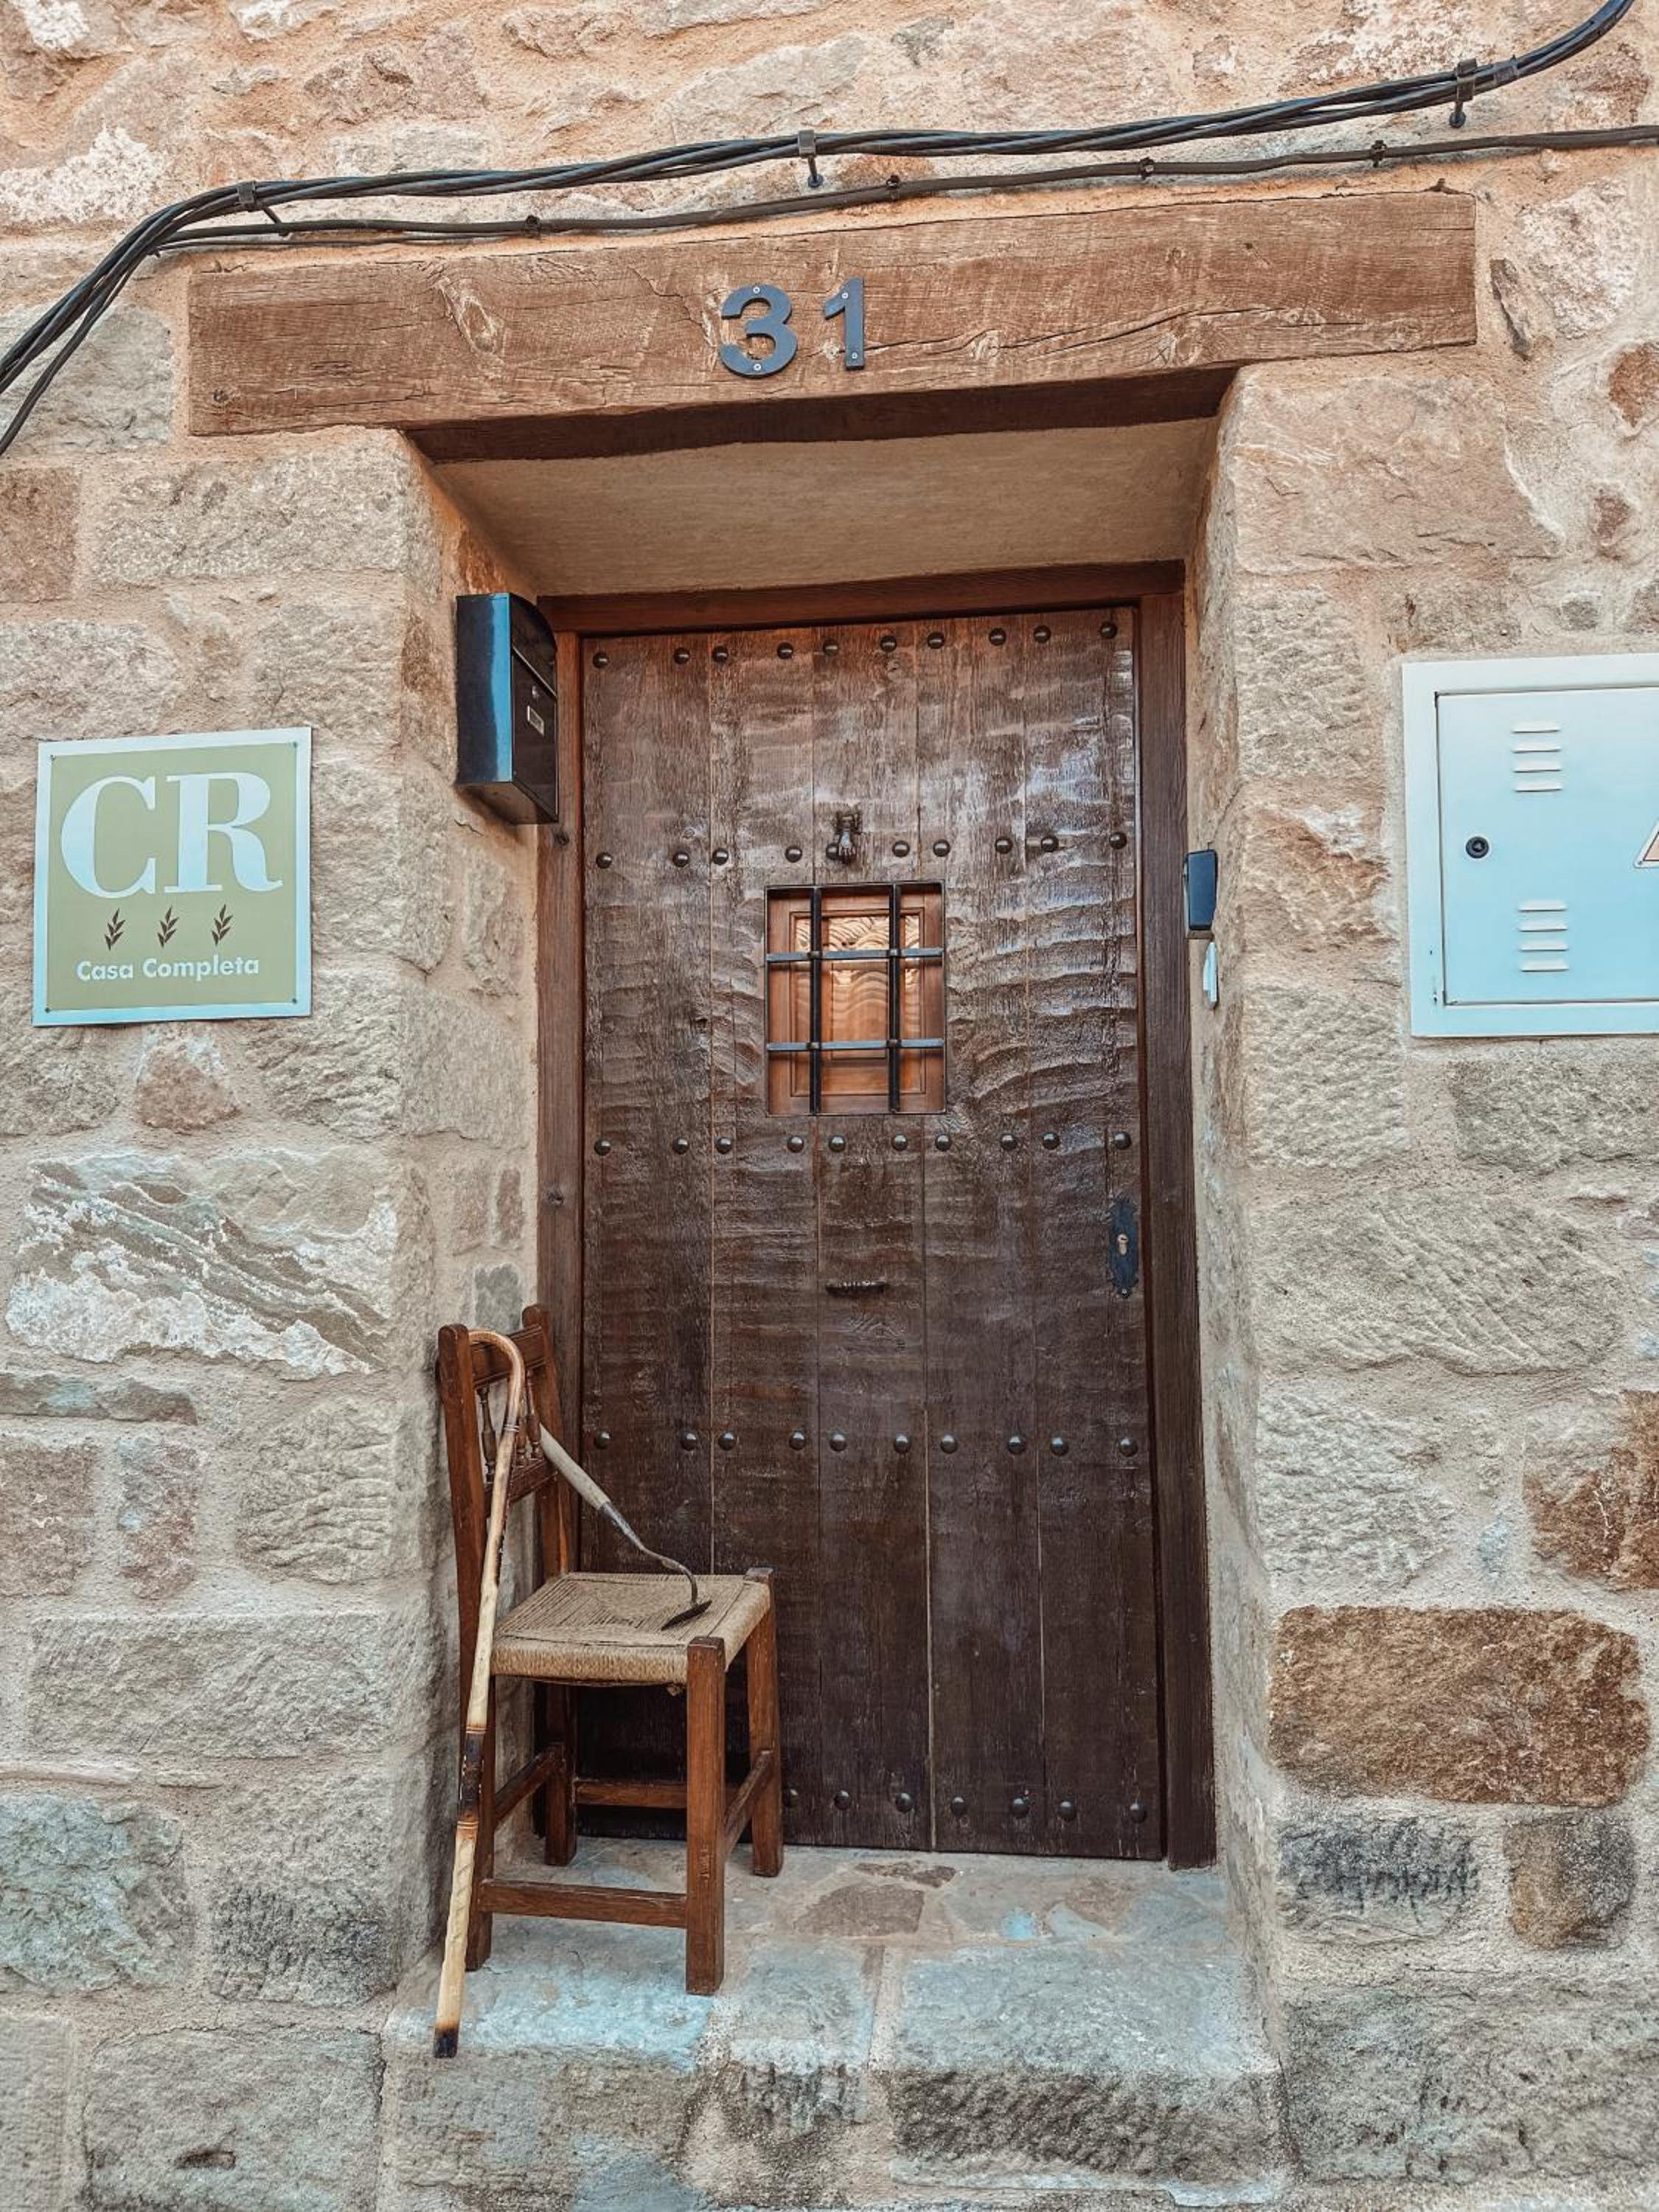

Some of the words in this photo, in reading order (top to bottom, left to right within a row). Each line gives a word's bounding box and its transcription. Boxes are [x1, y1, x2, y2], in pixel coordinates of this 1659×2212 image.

[719, 276, 866, 378] 31
[60, 771, 283, 899] CR
[77, 960, 134, 981] Casa
[142, 955, 260, 981] Completa
